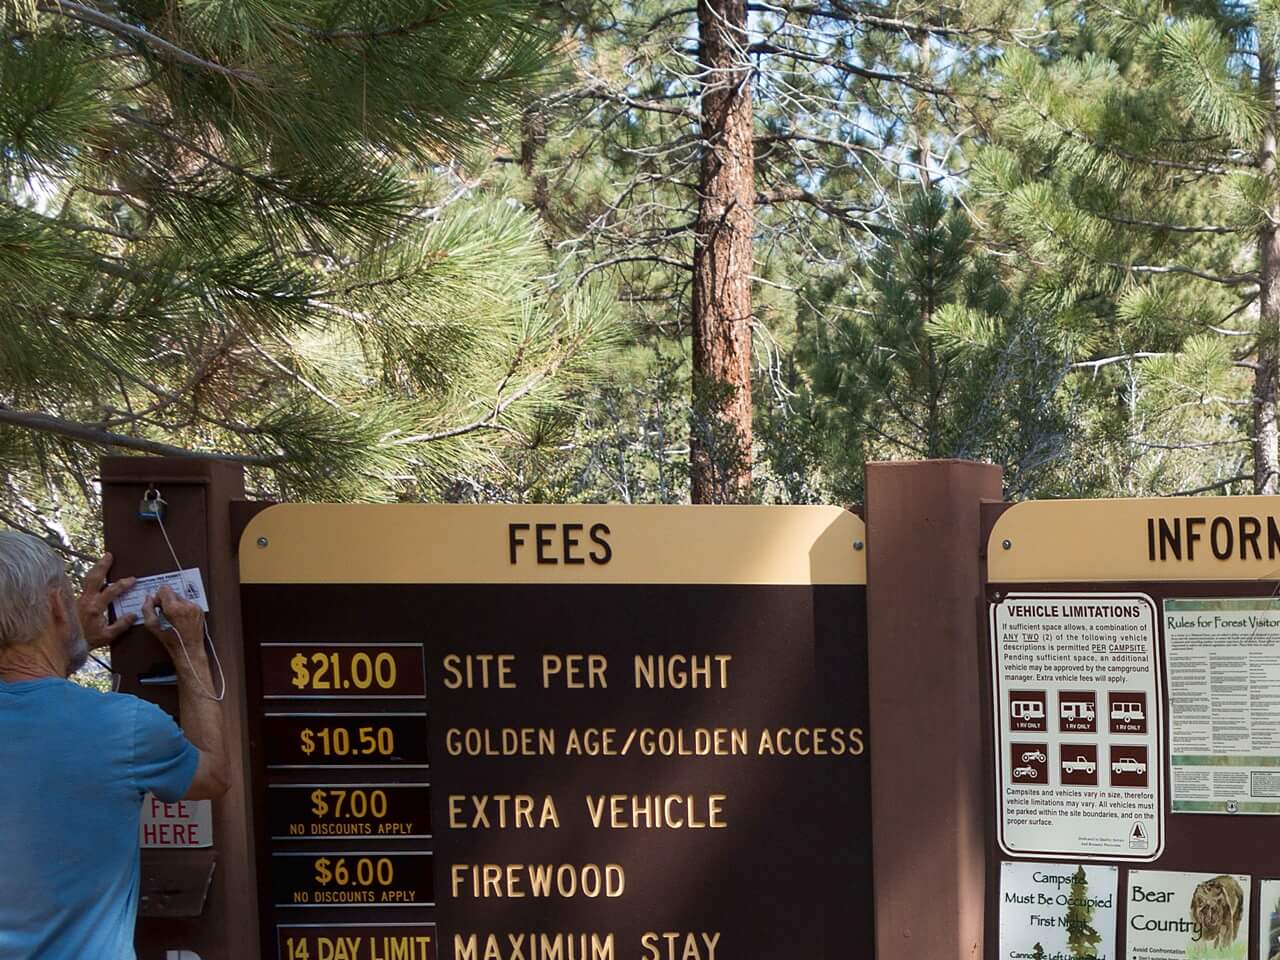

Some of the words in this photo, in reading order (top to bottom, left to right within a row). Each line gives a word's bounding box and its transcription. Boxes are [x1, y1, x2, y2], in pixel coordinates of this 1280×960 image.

[508, 523, 612, 565] FEES
[1007, 605, 1059, 617] VEHICLE
[1062, 605, 1140, 618] LIMITATIONS
[1167, 616, 1195, 630] Rules
[1197, 616, 1213, 628] for
[1214, 616, 1247, 629] Forest
[1003, 633, 1018, 641] ANY
[1022, 633, 1039, 641] TWO
[1042, 633, 1053, 641] (2)
[1081, 634, 1117, 643] following
[1003, 643, 1046, 651] descriptions
[1057, 643, 1090, 652] permitted
[1003, 653, 1034, 662] Pending
[1036, 653, 1071, 661] sufficient
[1112, 654, 1149, 662] additional
[290, 652, 397, 689] $21.00
[443, 655, 517, 689] SITE
[542, 655, 608, 689] PER
[634, 655, 732, 689] NIGHT
[1004, 663, 1028, 671] vehicle
[1107, 665, 1149, 673] campground
[1004, 674, 1034, 682] manager.
[300, 726, 394, 756] $10.50
[446, 728, 556, 756] GOLDEN
[566, 728, 748, 756] AGE/GOLDEN
[758, 728, 864, 756] ACCESS
[151, 797, 190, 818] FEE
[311, 789, 388, 819] $7.00
[448, 795, 560, 829] EXTRA
[586, 795, 728, 829] VEHICLE
[289, 824, 305, 835] NO
[310, 823, 372, 835] DISCOUNTS
[377, 823, 413, 835] APPLY
[1007, 818, 1027, 826] proper
[143, 823, 199, 845] HERE
[314, 858, 394, 886] $6.00
[451, 864, 626, 898] FIREWOOD
[293, 892, 308, 903] NO
[314, 891, 375, 903] DISCOUNTS
[381, 891, 416, 903] APPLY
[1004, 893, 1034, 905] Must
[1037, 894, 1053, 906] Be
[1056, 894, 1112, 912] Occupied
[1132, 885, 1175, 903] Bear
[1030, 915, 1056, 927] First
[1130, 914, 1202, 941] Country
[1049, 951, 1063, 960] Left
